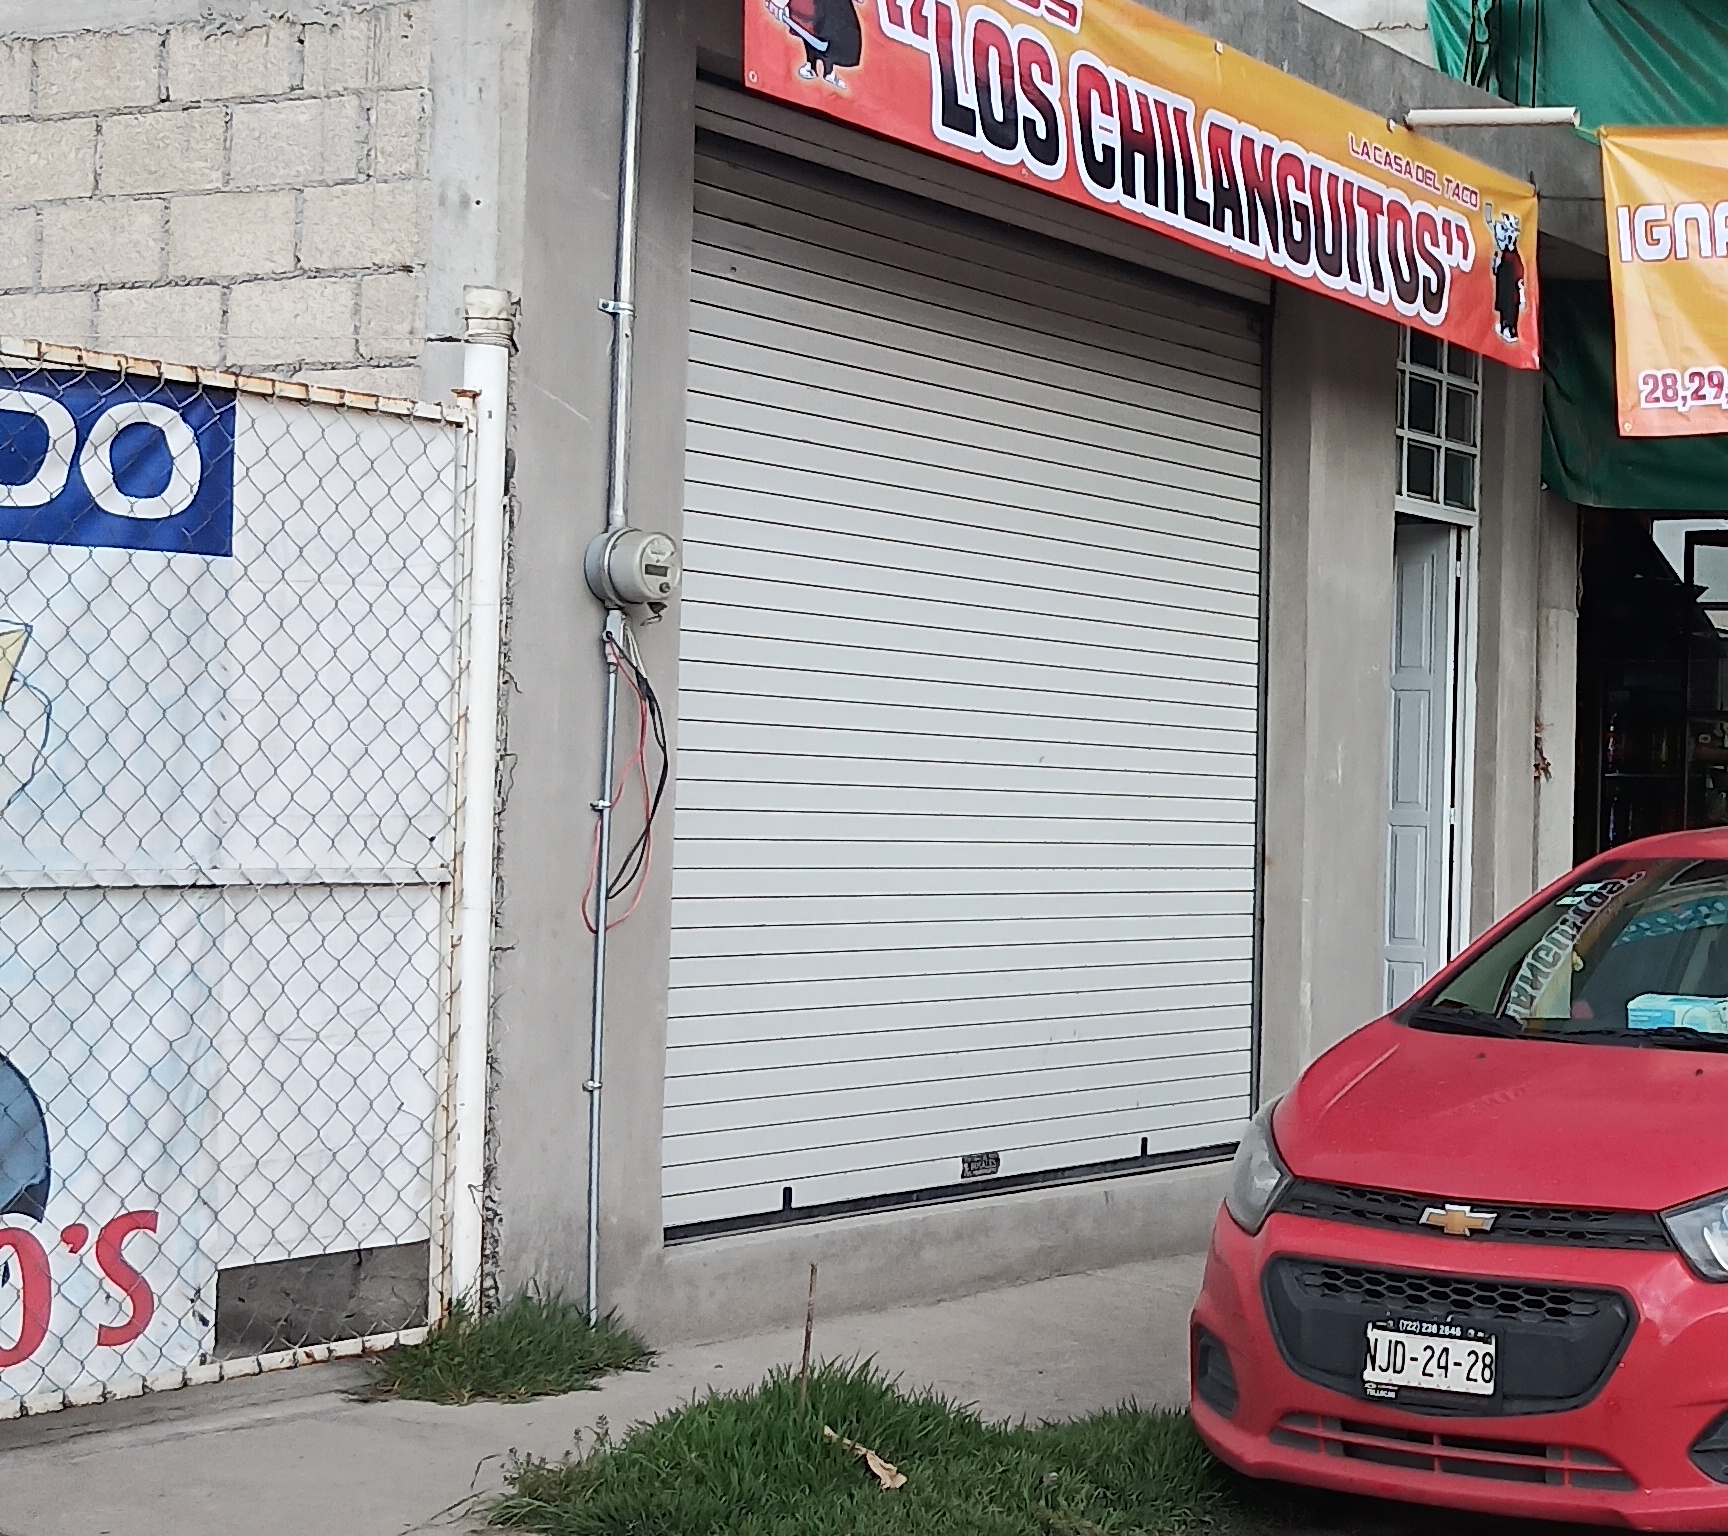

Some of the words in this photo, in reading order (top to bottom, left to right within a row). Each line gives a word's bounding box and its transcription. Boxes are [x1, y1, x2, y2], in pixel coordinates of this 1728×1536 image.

[1349, 134, 1372, 162] LA
[1373, 144, 1414, 179] CASA
[1415, 164, 1441, 192] DEL
[1444, 176, 1479, 209] TACO
